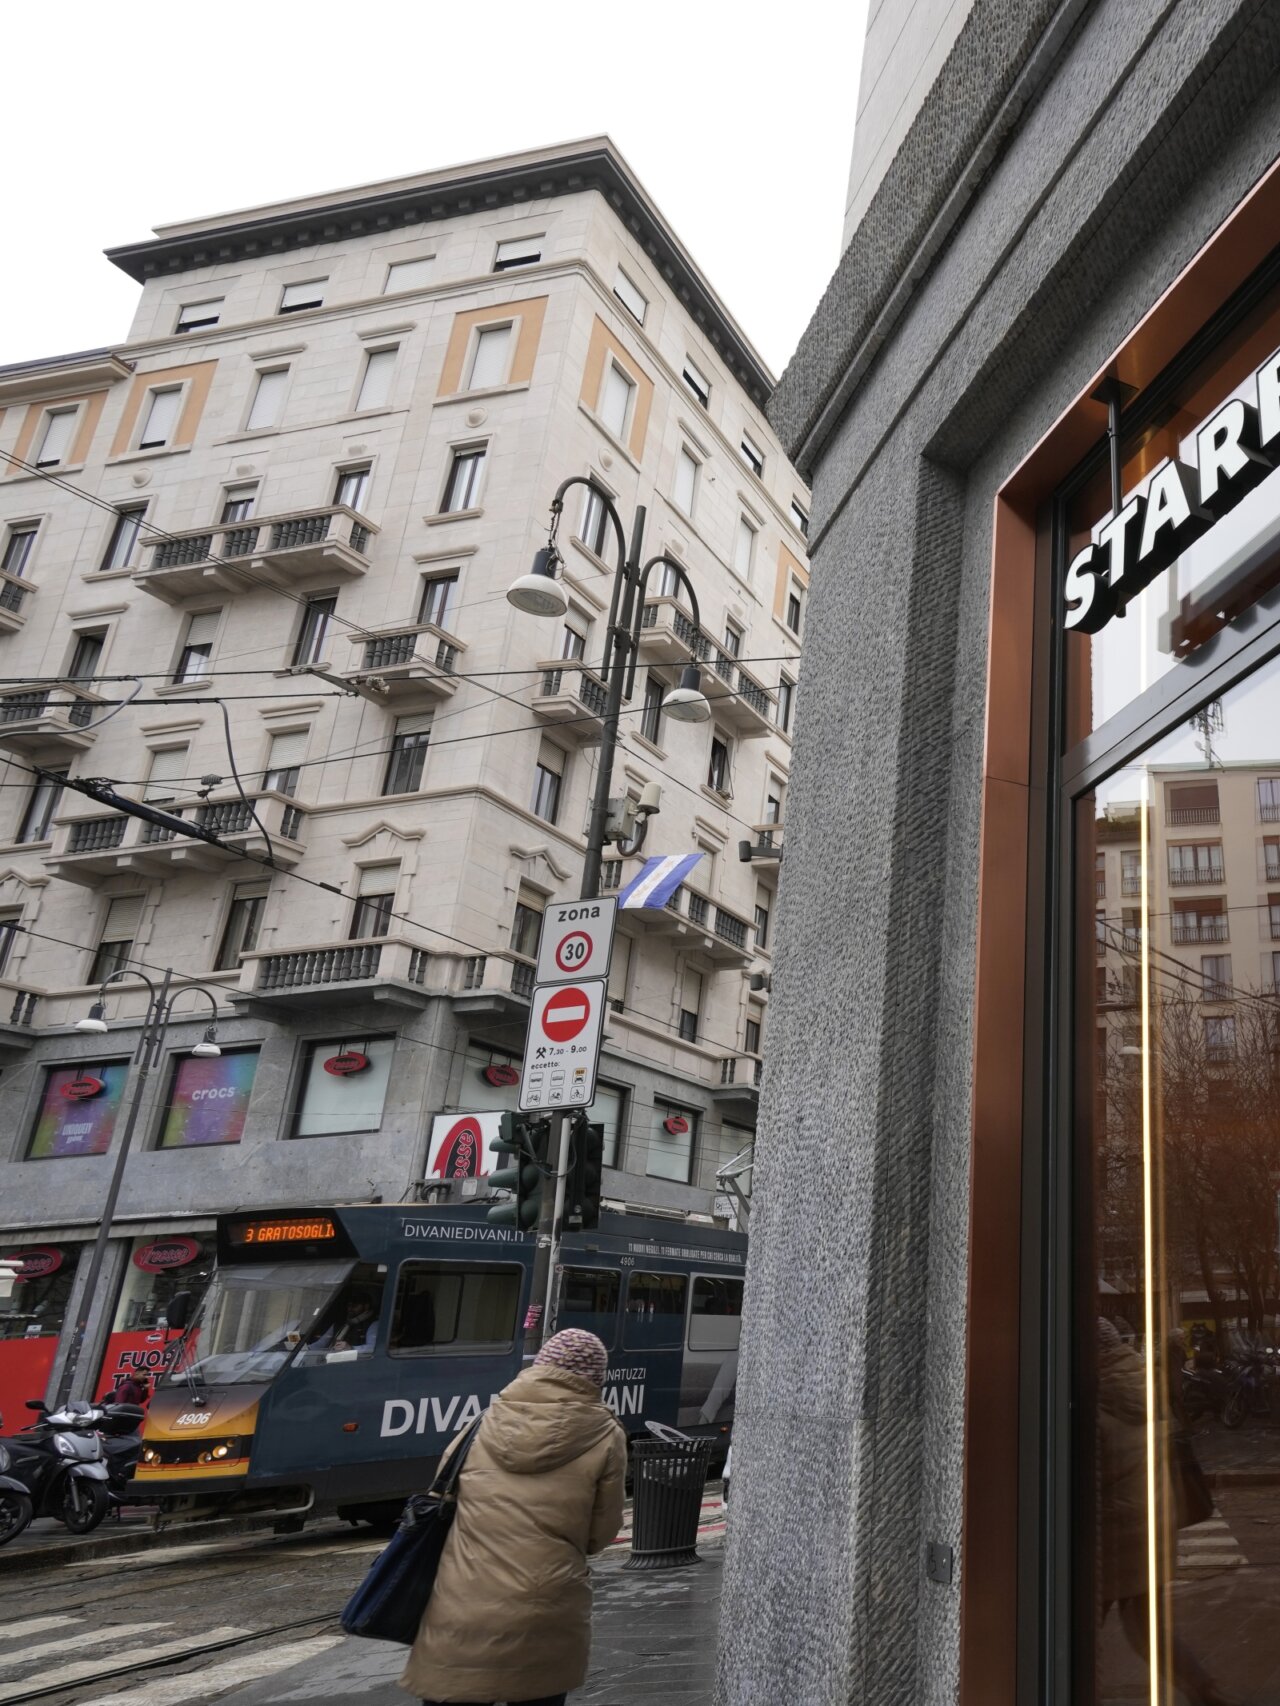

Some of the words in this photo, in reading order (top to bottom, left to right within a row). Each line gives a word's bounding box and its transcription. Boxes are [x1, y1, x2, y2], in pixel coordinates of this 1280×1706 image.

[557, 905, 600, 922] zona
[564, 942, 585, 961] 30
[192, 1086, 236, 1101] crocs
[245, 1229, 254, 1242] 3
[620, 1256, 635, 1266] 4906
[607, 1367, 646, 1381] NATUZZI
[176, 1412, 212, 1425] 4906
